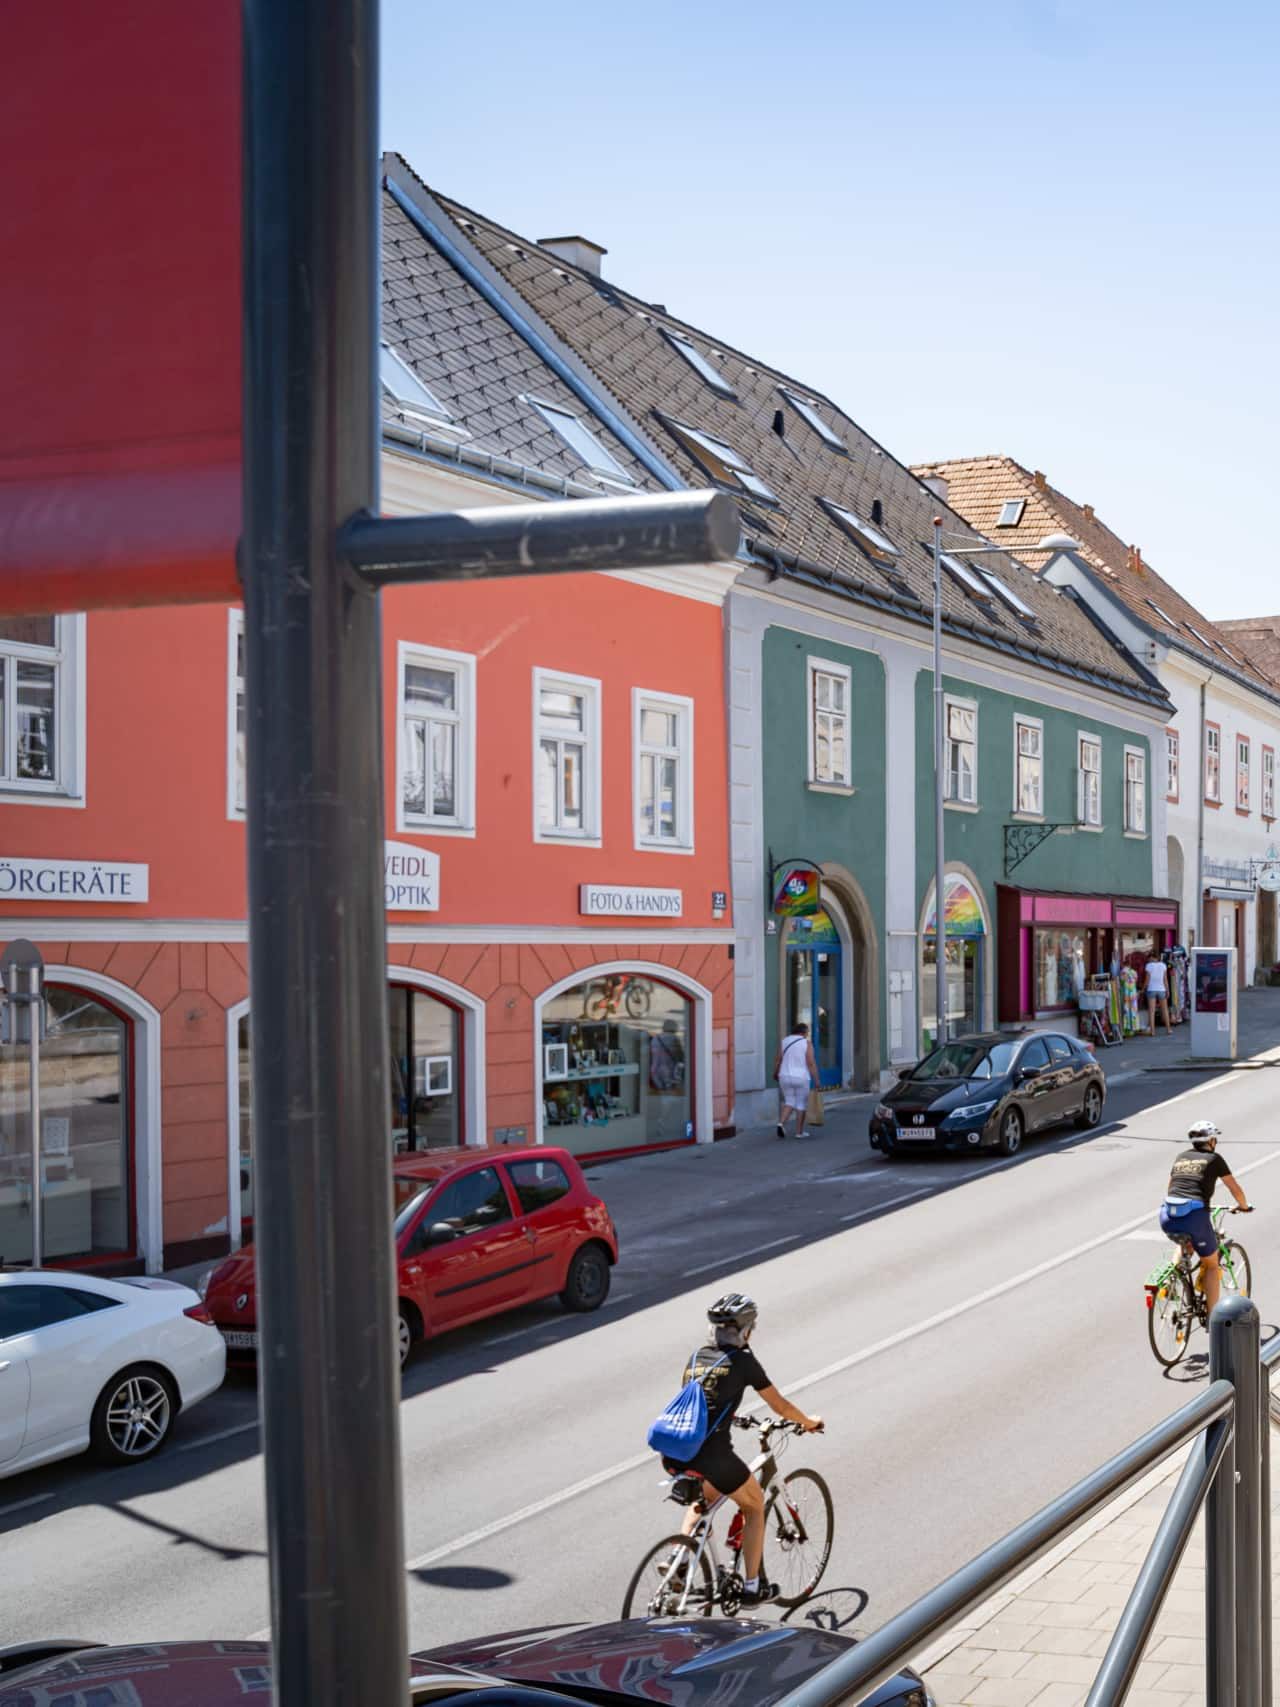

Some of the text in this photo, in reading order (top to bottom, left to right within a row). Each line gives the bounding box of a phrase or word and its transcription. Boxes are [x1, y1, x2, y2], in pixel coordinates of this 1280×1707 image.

[0, 863, 131, 895] ÖRGERÄTE
[384, 884, 431, 905] OPTIK
[590, 892, 680, 912] FOTO & HANDYS
